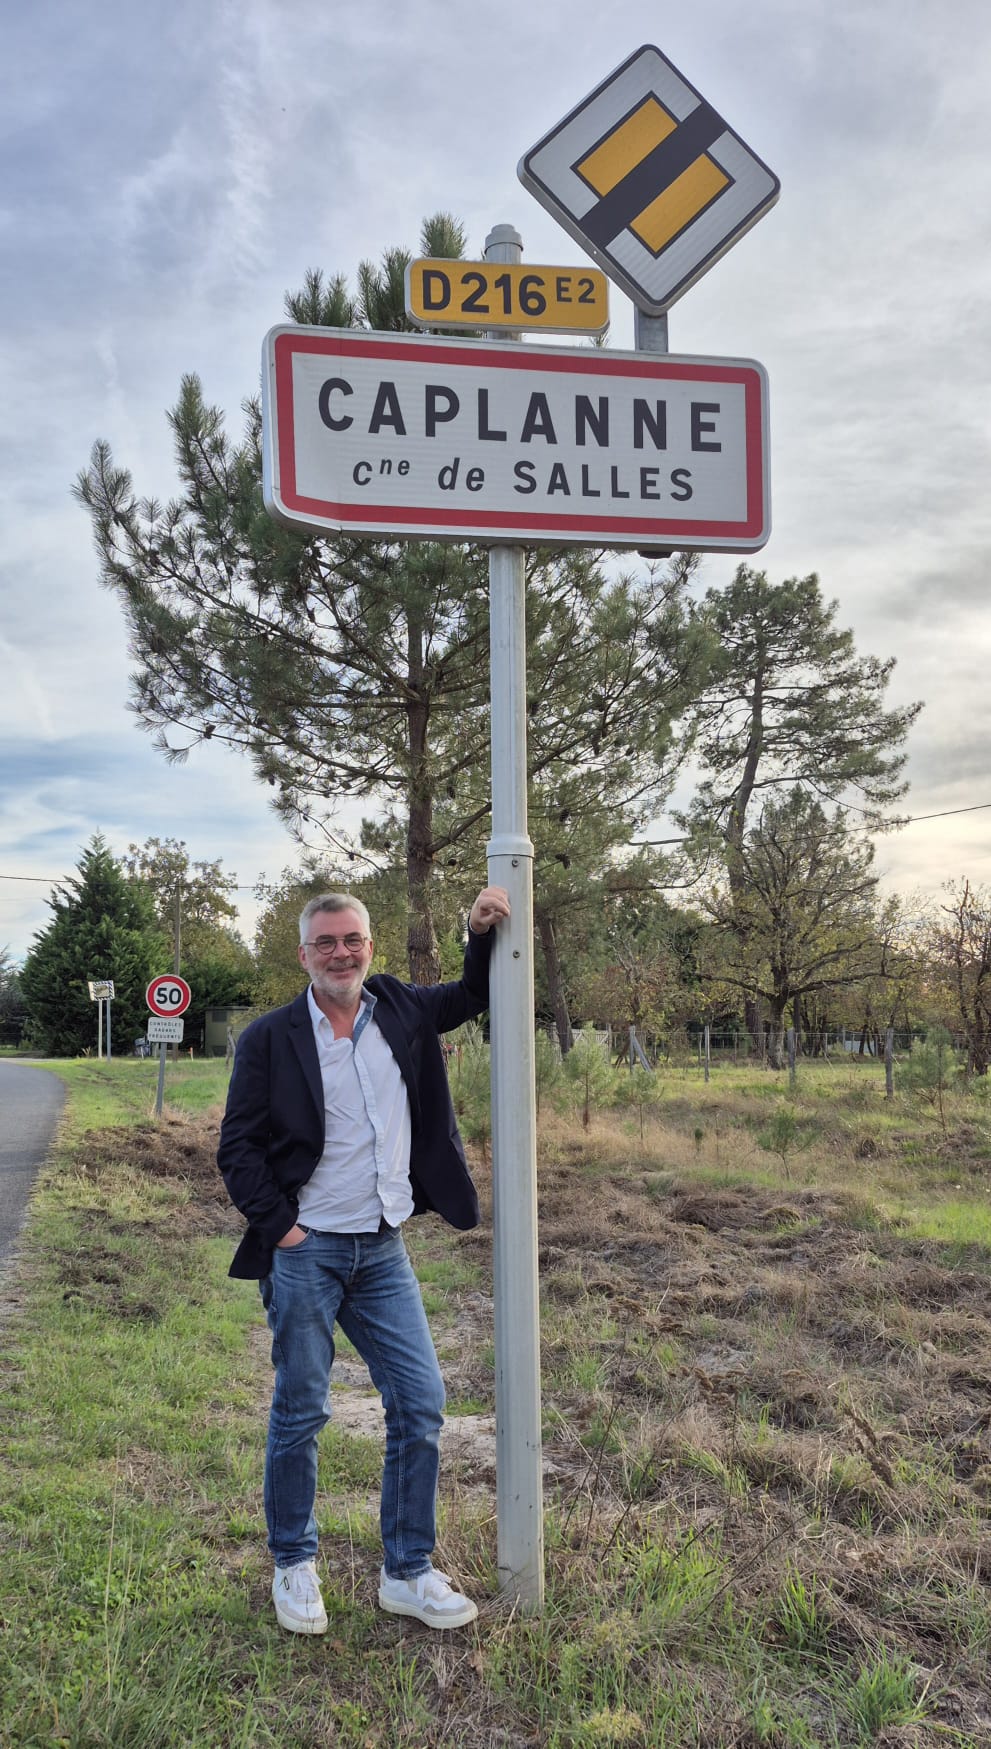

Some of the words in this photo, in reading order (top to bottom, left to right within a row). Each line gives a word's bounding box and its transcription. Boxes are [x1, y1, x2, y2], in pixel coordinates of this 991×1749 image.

[318, 377, 722, 453] CAPLANNE
[437, 457, 486, 492] de
[513, 460, 694, 502] SALLES
[156, 987, 182, 1005] 50
